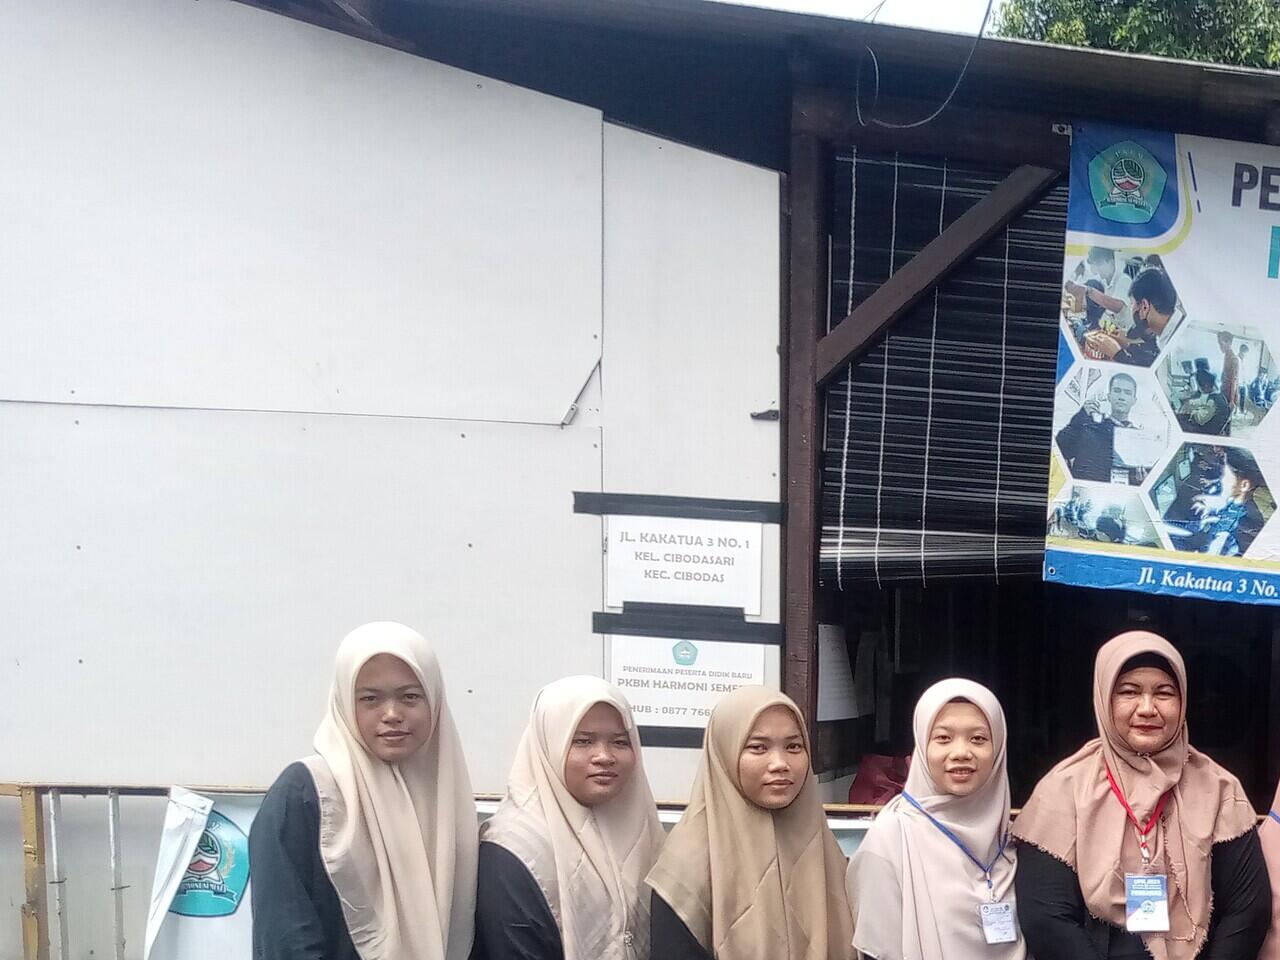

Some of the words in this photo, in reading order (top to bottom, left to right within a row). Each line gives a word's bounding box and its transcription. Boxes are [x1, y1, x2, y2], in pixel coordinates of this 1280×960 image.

[619, 531, 636, 543] JL.
[639, 532, 704, 547] KAKATUA
[707, 537, 715, 547] 3
[717, 537, 742, 549] NO.
[634, 551, 660, 562] KEL.
[663, 553, 735, 566] CIBODASARI
[644, 569, 670, 580] KEC.
[673, 571, 725, 583] CIBODAS
[1137, 566, 1156, 586] Jl.
[1161, 569, 1233, 594] Kakatua
[1236, 578, 1248, 594] 3
[1251, 579, 1279, 598] No.
[617, 678, 650, 688] PKBM
[652, 680, 708, 692] HARMONI
[661, 706, 688, 716] 0877
